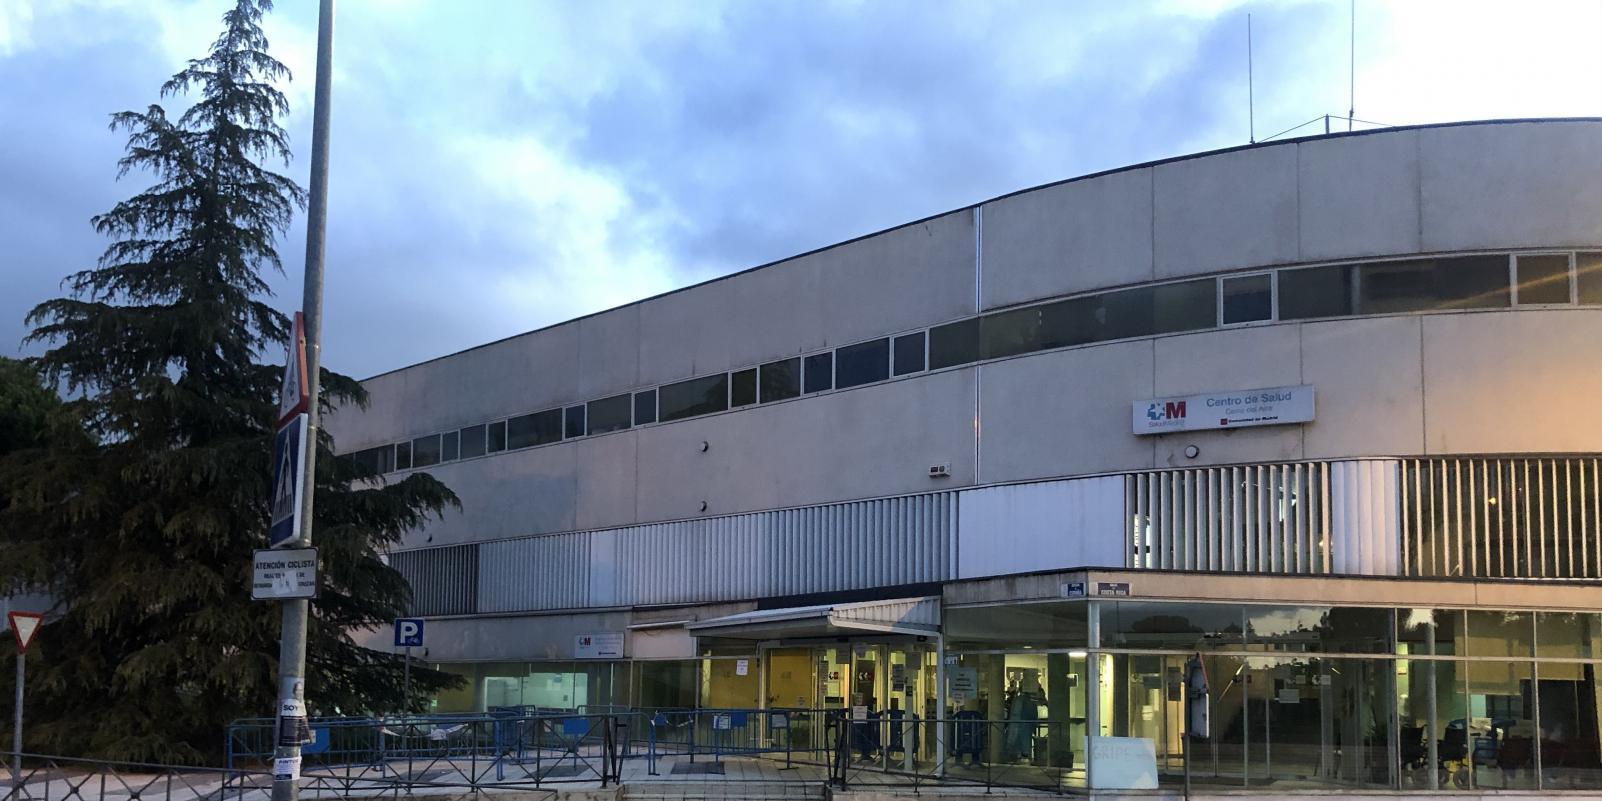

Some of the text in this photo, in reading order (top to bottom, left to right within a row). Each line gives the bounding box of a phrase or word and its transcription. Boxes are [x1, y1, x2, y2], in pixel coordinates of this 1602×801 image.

[1206, 391, 1292, 407] Centro de Salud
[1166, 401, 1186, 419] M
[256, 560, 315, 570] ATENCIÓN CICLISTA
[400, 622, 418, 643] P
